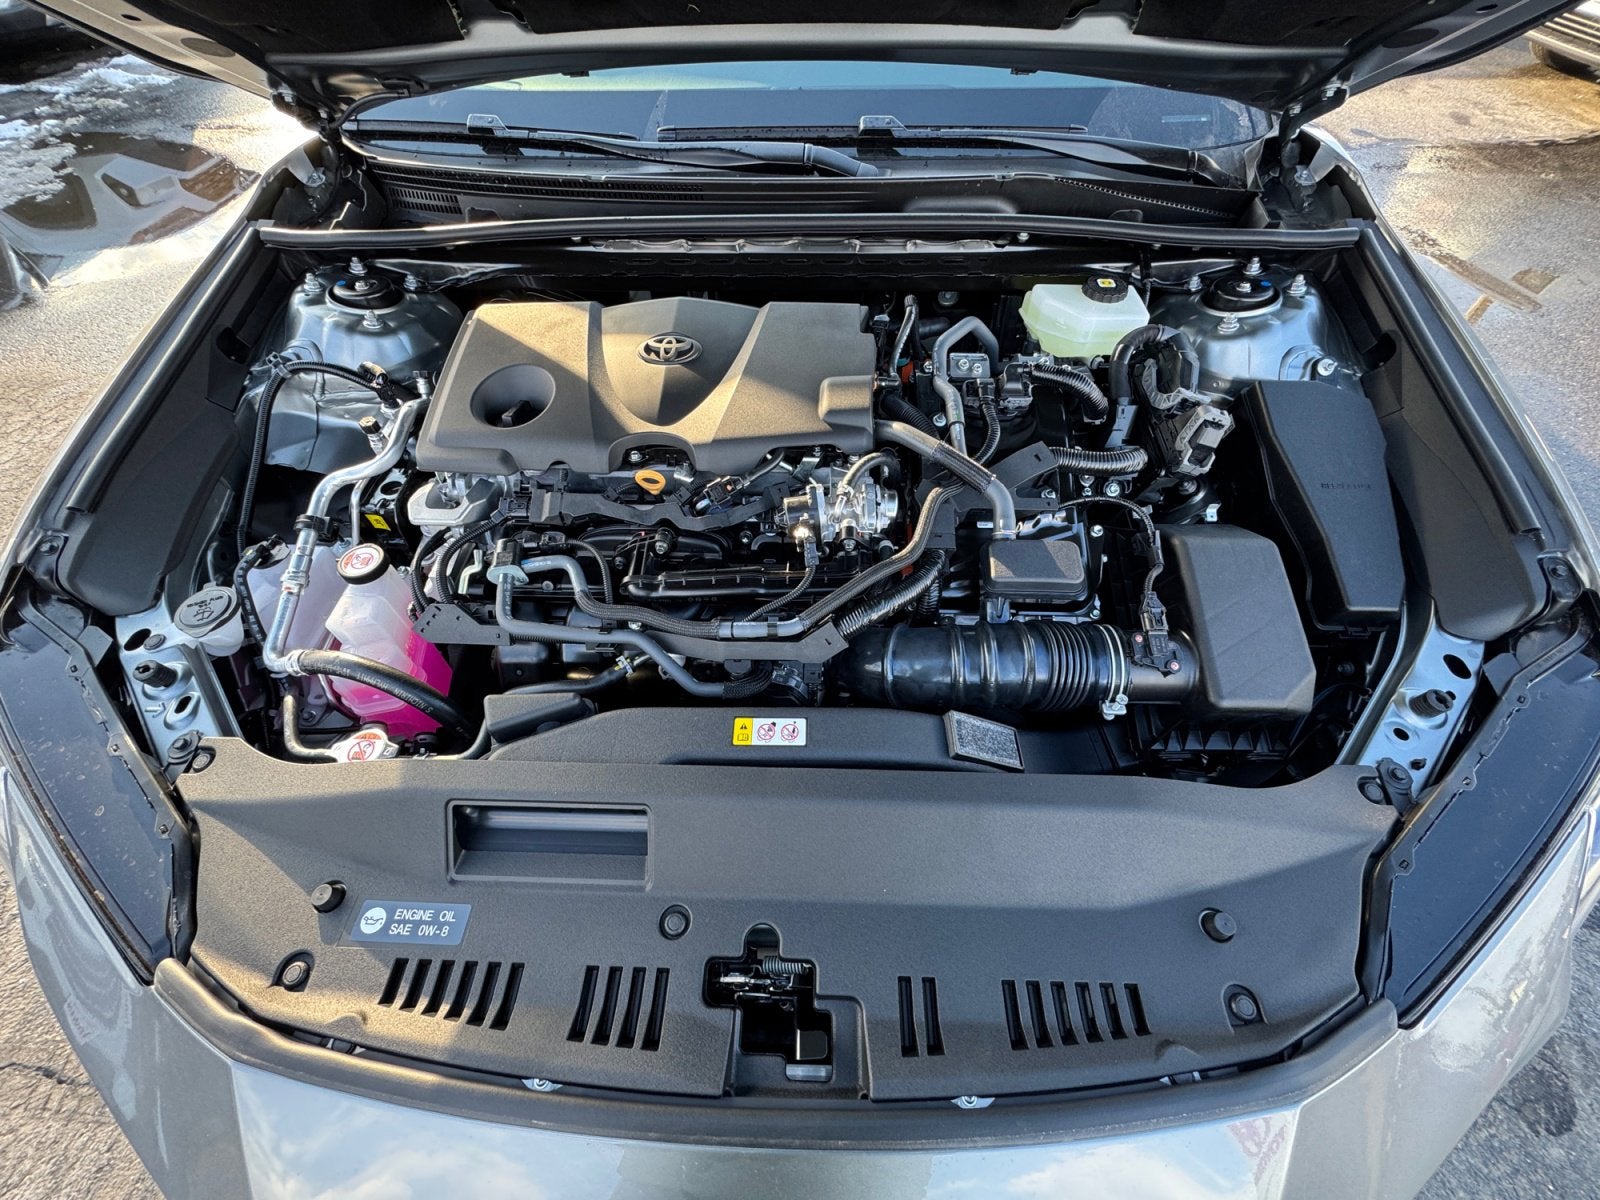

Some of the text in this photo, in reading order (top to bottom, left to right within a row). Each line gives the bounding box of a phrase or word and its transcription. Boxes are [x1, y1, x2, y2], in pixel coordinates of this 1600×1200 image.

[393, 908, 457, 922] ENGINE OIL
[388, 923, 450, 937] SAE 0W-8
